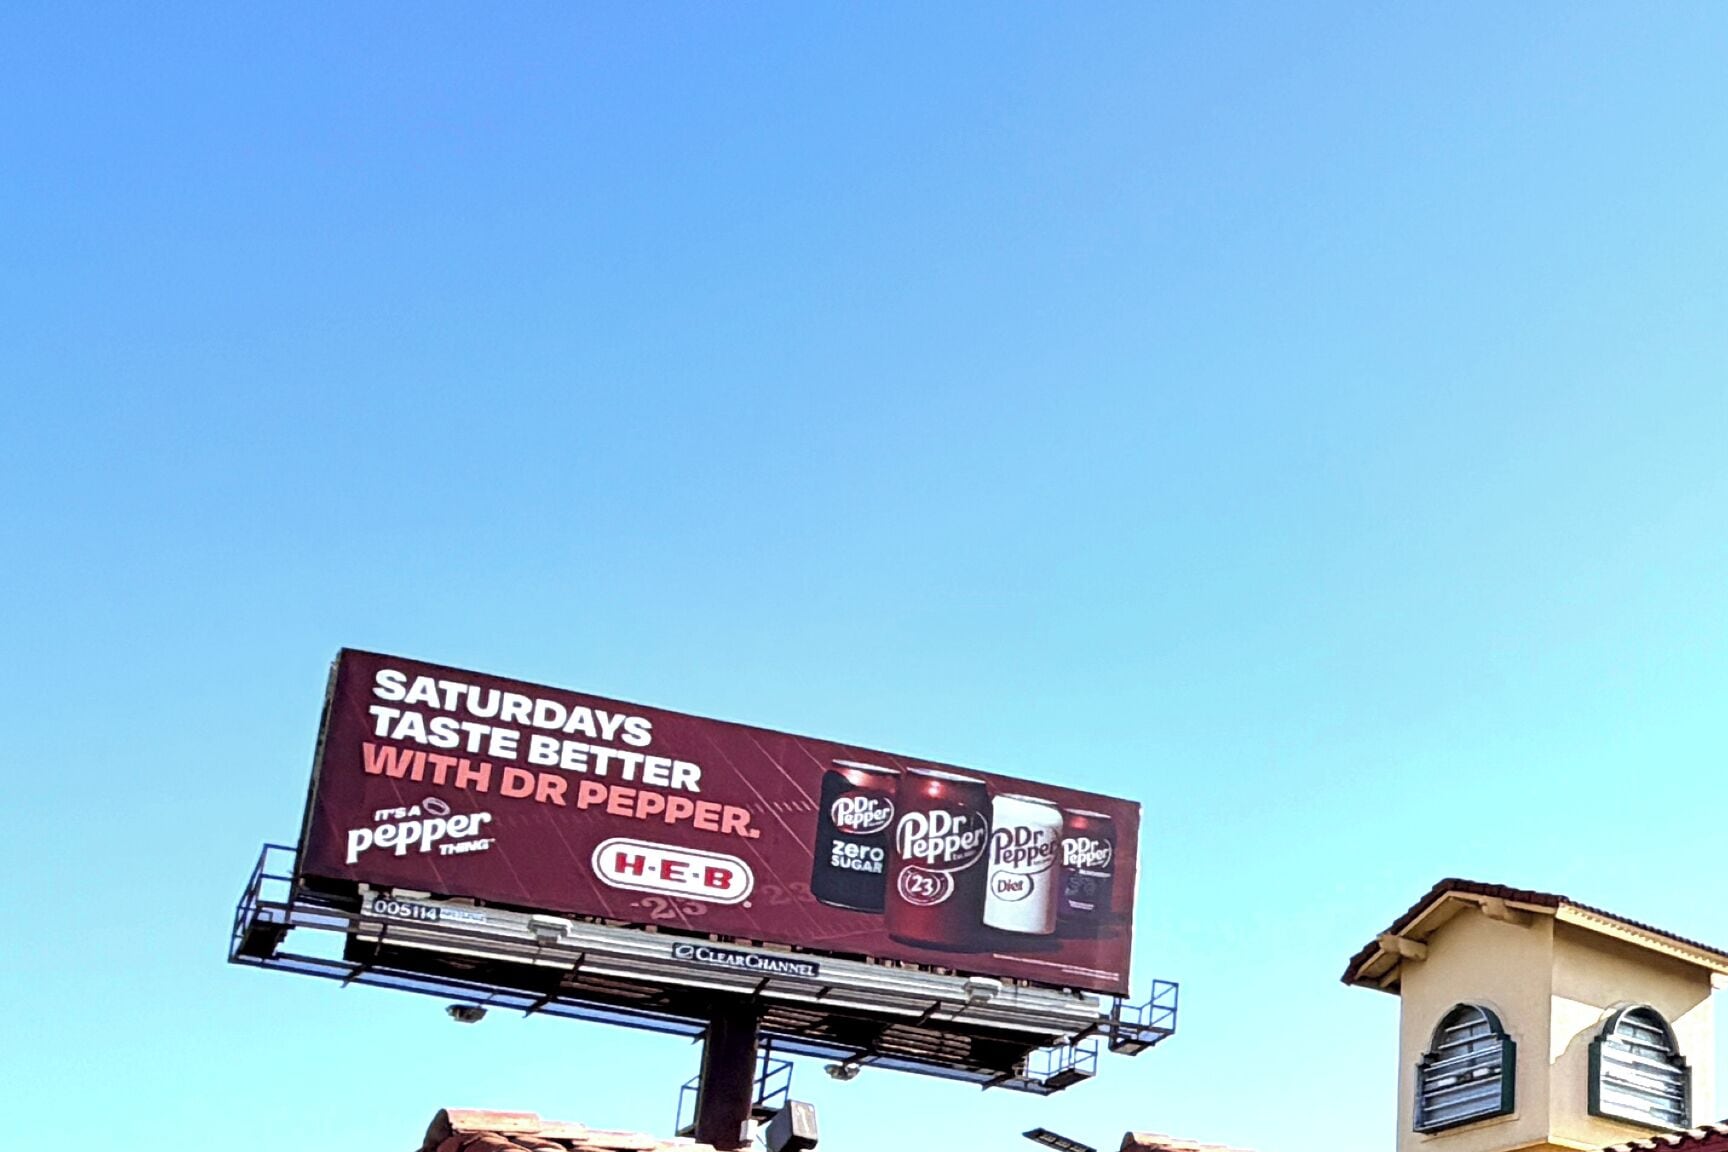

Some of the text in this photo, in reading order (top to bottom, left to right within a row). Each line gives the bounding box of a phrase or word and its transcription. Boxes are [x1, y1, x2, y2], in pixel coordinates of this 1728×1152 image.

[372, 669, 653, 746] SATURDAYS
[369, 705, 702, 793] TASTE BETTER
[362, 742, 761, 839] WITH DR PEPPER.
[374, 805, 422, 821] IT'S A
[835, 798, 891, 829] Pepper
[854, 797, 879, 812] Dr
[929, 810, 967, 838] Dr
[346, 812, 492, 864] pepper
[439, 839, 490, 855] THING
[902, 812, 984, 864] Pepper
[1014, 826, 1044, 847] Dr
[1077, 837, 1099, 856] Dr
[832, 840, 885, 861] zero
[994, 828, 1058, 868] Pepper
[1061, 838, 1109, 867] Pepper
[831, 855, 883, 874] SUGAR
[911, 874, 934, 896] 23
[997, 879, 1024, 893] Diet
[374, 900, 437, 920] 005114
